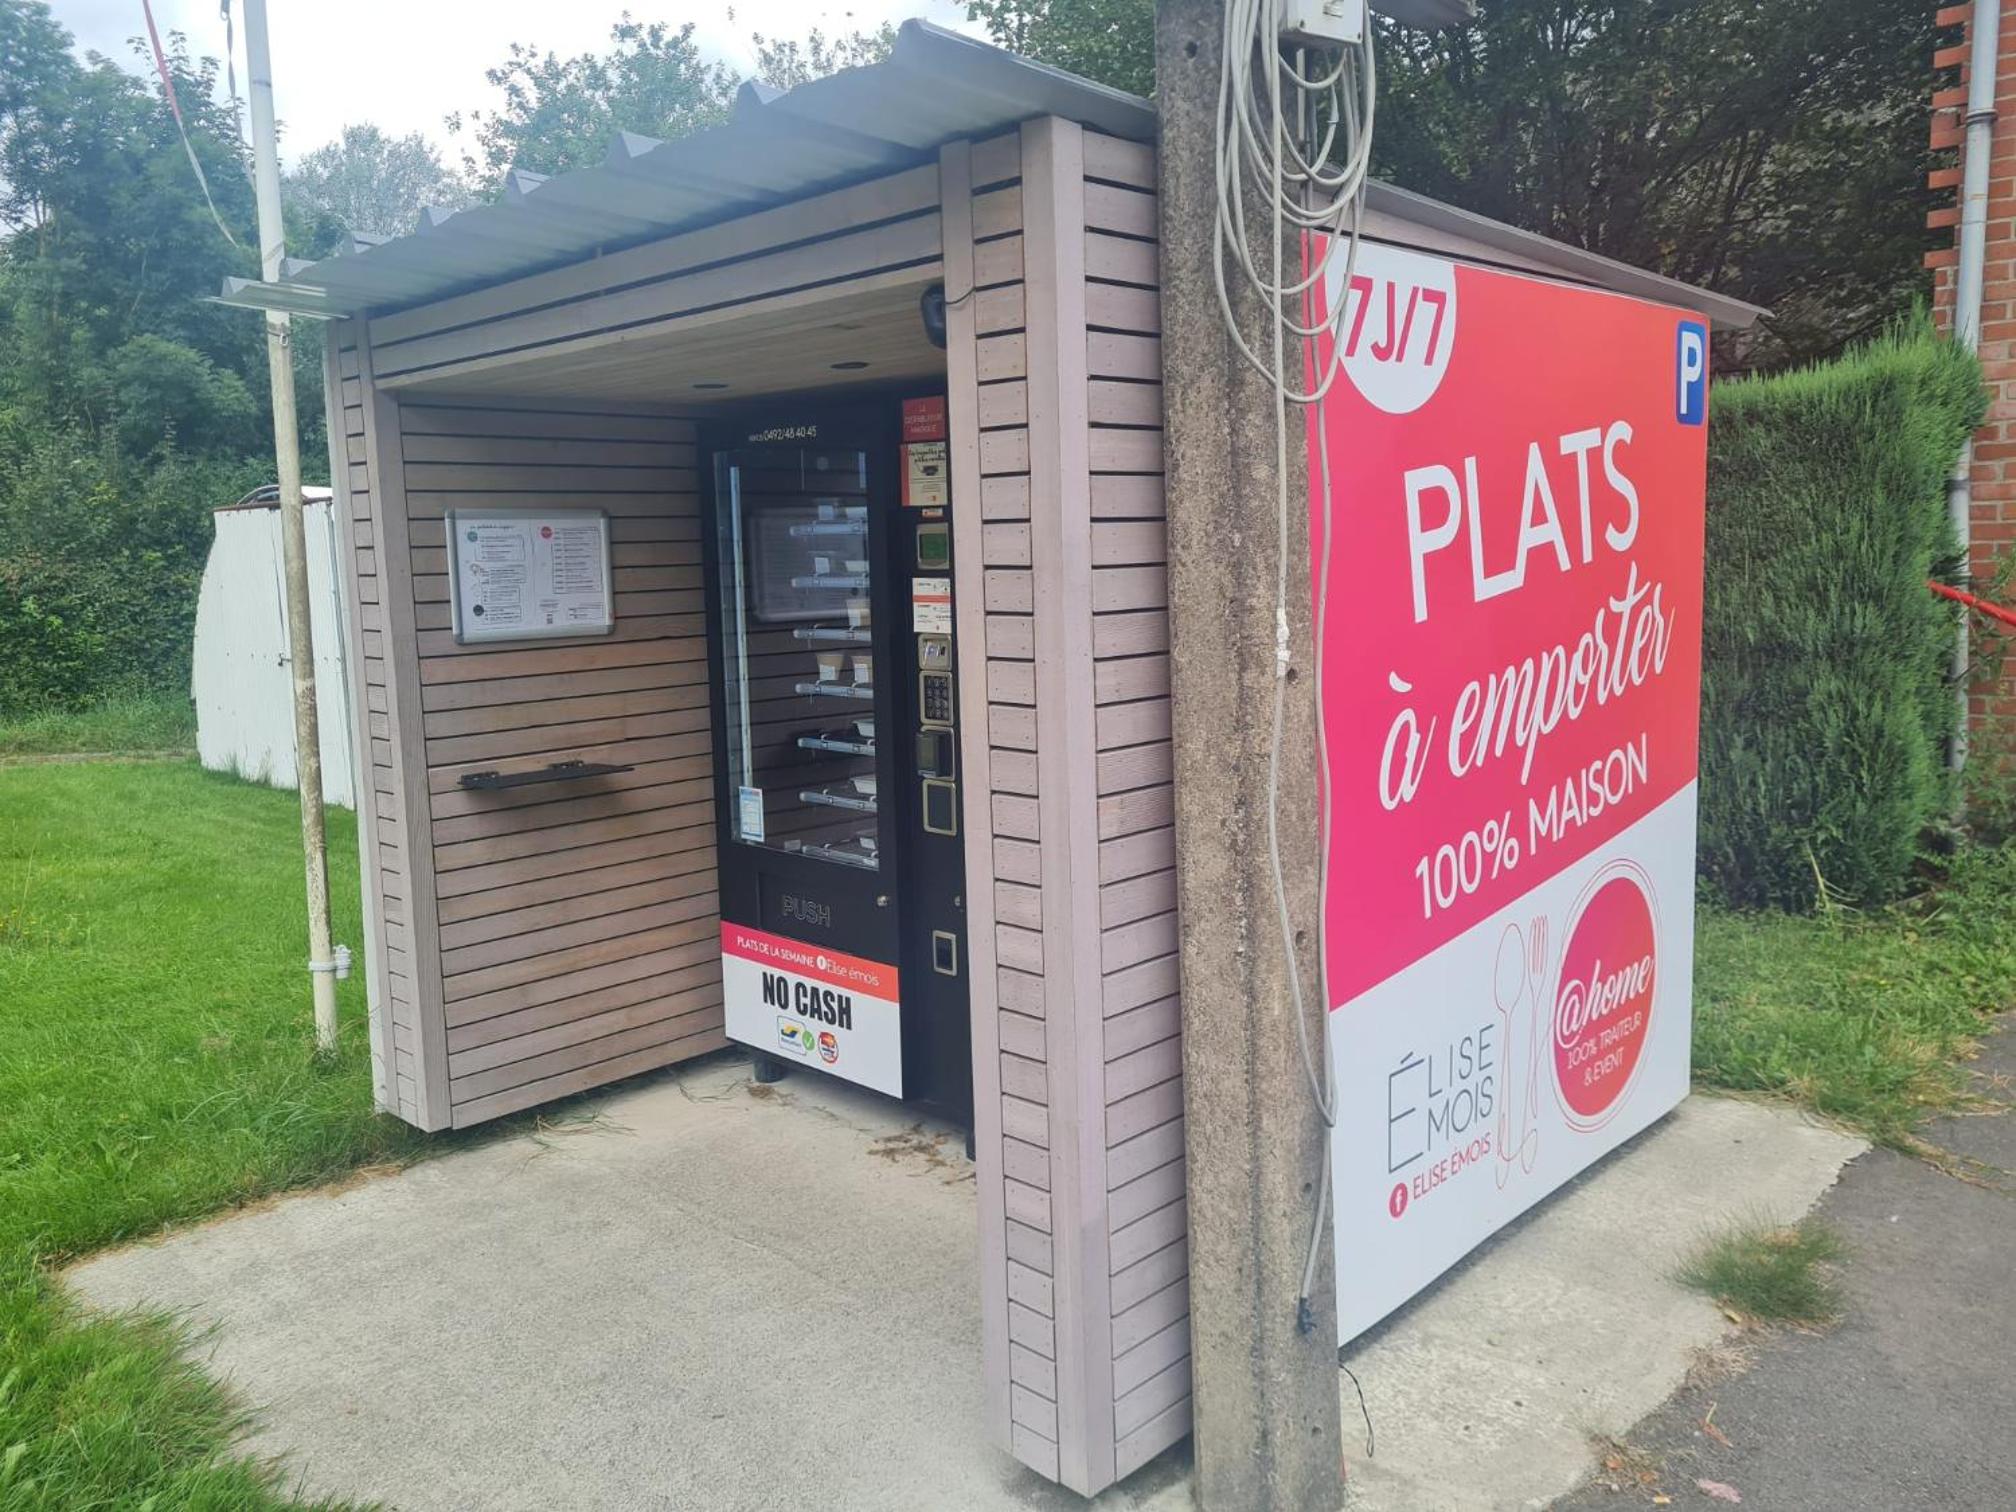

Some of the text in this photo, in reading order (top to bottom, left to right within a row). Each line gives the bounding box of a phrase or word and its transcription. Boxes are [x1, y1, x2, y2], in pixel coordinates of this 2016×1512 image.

[1344, 273, 1447, 367] 7J/7
[1680, 330, 1702, 415] P
[1403, 420, 1640, 624] PLATS
[1378, 561, 1676, 812] à emporter
[1414, 732, 1648, 920] 100% MAISON
[782, 893, 831, 928] PUSH
[737, 935, 759, 952] PLATS
[758, 941, 770, 955] DE
[770, 944, 780, 957] LA
[781, 947, 815, 968] SEMAINE
[763, 971, 852, 1030] NO CASH
[1555, 955, 1651, 1049] @home
[1567, 1011, 1643, 1070] 100% TRAITEUR
[1584, 1047, 1625, 1086] & EVENT
[1413, 1160, 1448, 1200] ELISE
